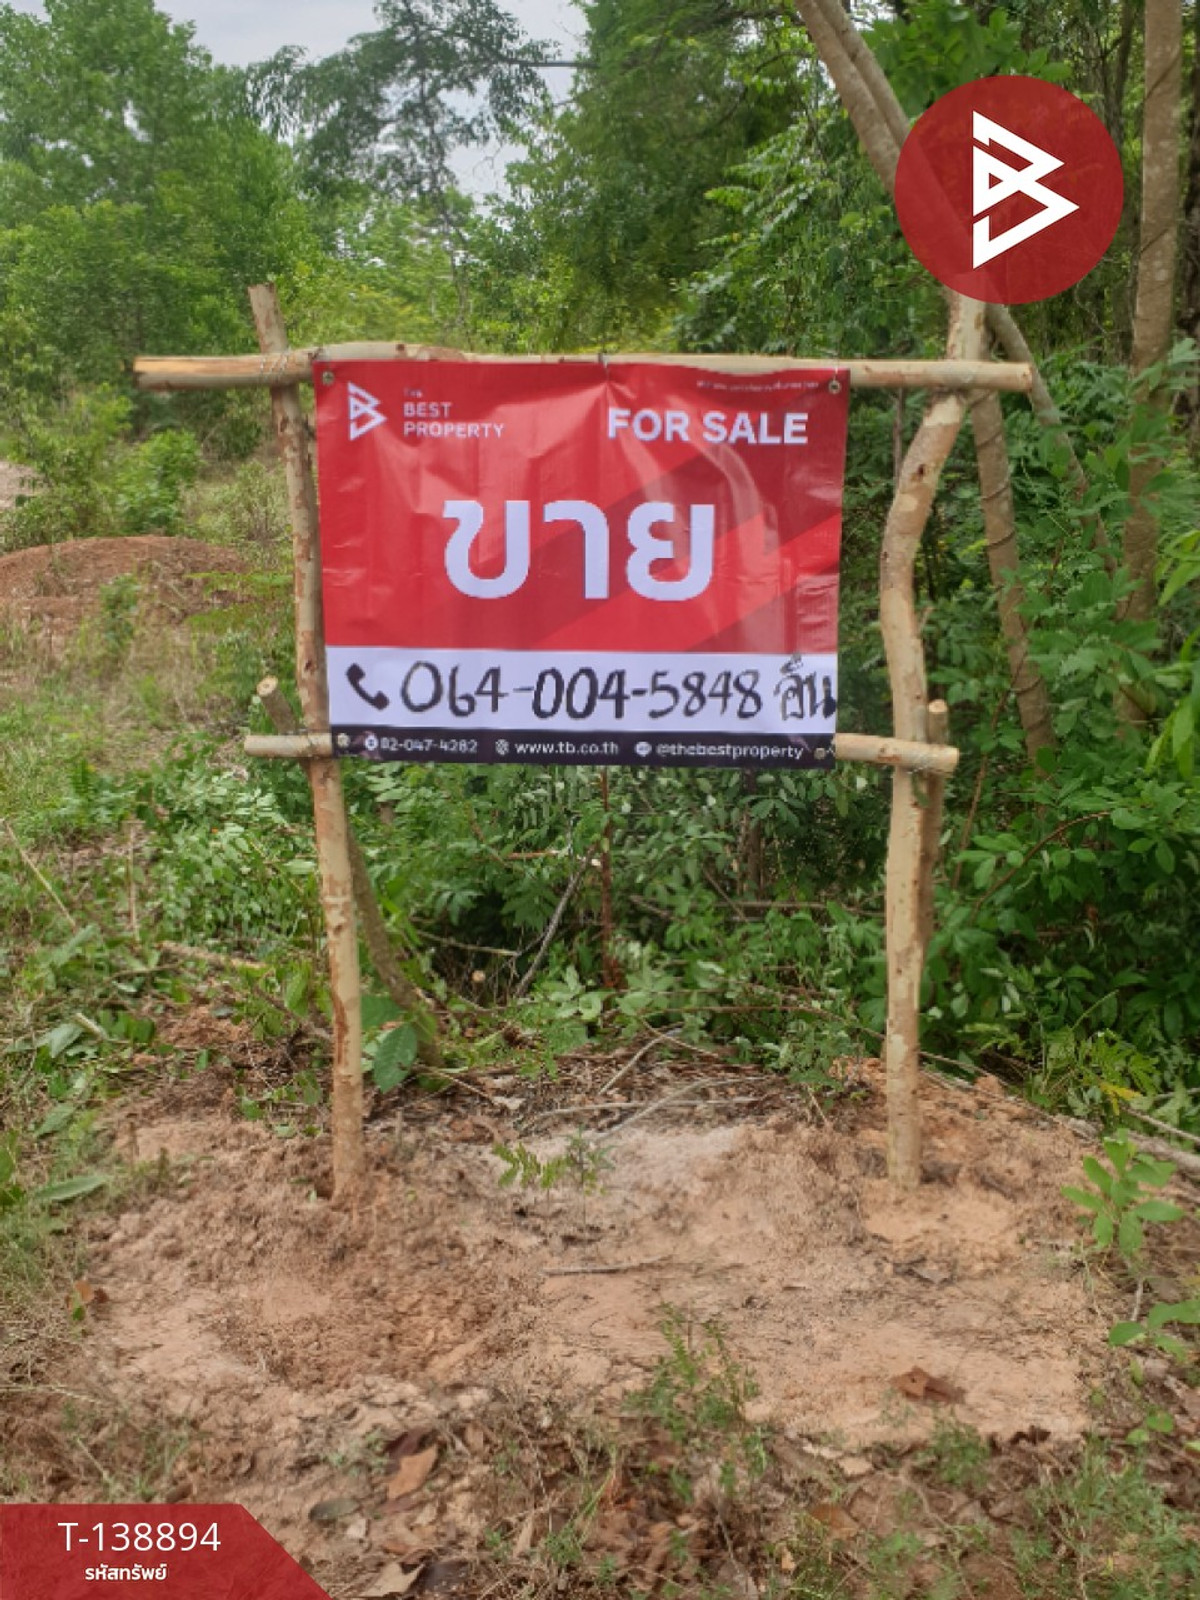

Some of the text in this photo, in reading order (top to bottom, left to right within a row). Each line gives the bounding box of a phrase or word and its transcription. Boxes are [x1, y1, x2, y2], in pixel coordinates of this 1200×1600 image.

[403, 401, 452, 418] BEST
[403, 421, 505, 438] PROPERTY
[607, 406, 809, 445] FOR SALE
[442, 499, 716, 602] ขาย
[401, 660, 763, 720] 064-004-5848
[514, 740, 619, 756] www.tb.co.th
[656, 742, 804, 760] @thebestproperty
